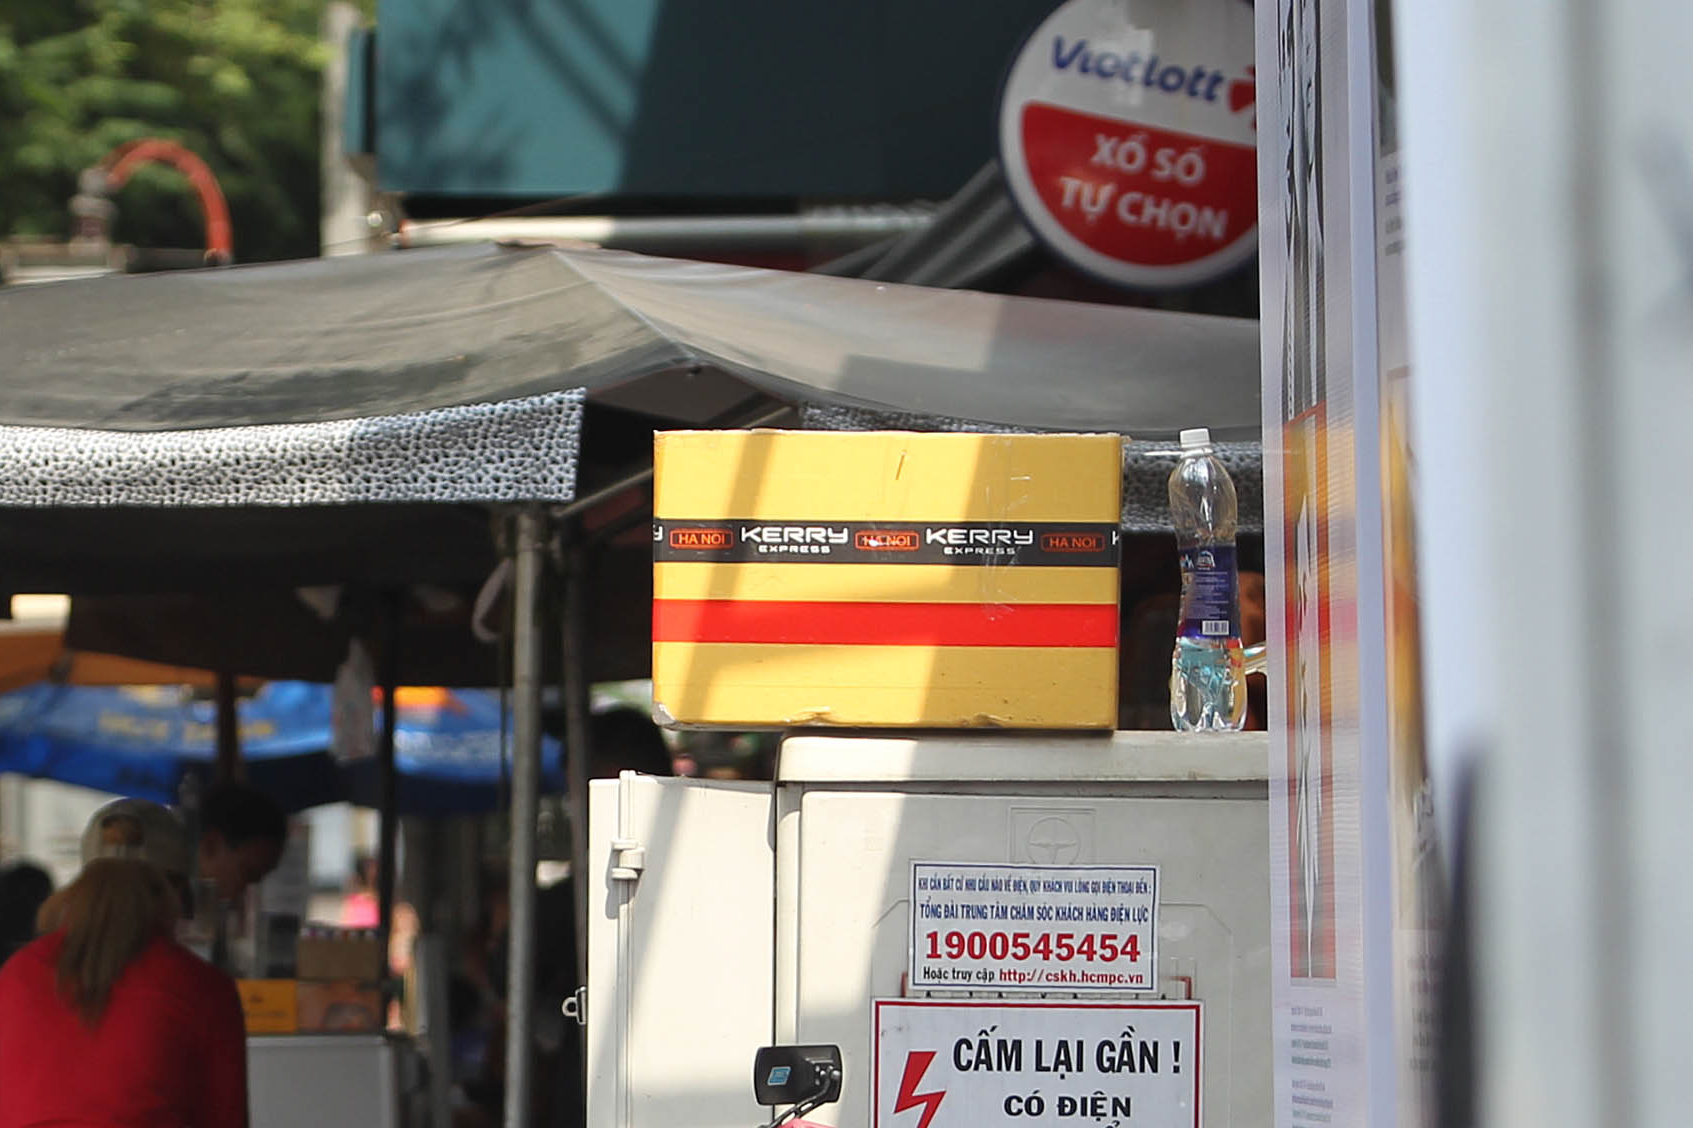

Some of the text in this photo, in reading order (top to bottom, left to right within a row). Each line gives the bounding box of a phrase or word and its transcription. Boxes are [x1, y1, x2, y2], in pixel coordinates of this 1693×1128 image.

[1053, 35, 1224, 101] Vietlott
[1152, 145, 1205, 186] SỐ
[1059, 176, 1228, 243] TỰ CHỌN
[679, 533, 725, 545] HA NOI
[741, 526, 848, 544] KERRY
[886, 535, 910, 546] NOI
[926, 528, 1034, 545] KERRY
[1050, 536, 1096, 547] HA NOI
[758, 545, 830, 554] EXPRESS
[943, 546, 1016, 555] EXPRESS
[920, 895, 942, 919] TỔNG
[943, 899, 958, 919] ĐÀI
[960, 903, 988, 920] TRUNG
[990, 900, 1008, 920] TÂM
[1036, 901, 1053, 921] SÓC
[1055, 901, 1084, 921] KHÁCH
[1086, 902, 1108, 922] HÀNG
[1110, 903, 1130, 925] ĐIỆN
[1132, 904, 1149, 926] LỰC
[926, 930, 1141, 963] 1900545454
[923, 966, 948, 983] Hoặc
[951, 968, 972, 984] truy
[976, 968, 995, 985] cập
[953, 1025, 1022, 1073] CẤM
[1035, 1039, 1084, 1080] LẠI
[1095, 1025, 1159, 1074] GẦN
[1004, 1090, 1131, 1122] CÓ ĐIỆN
